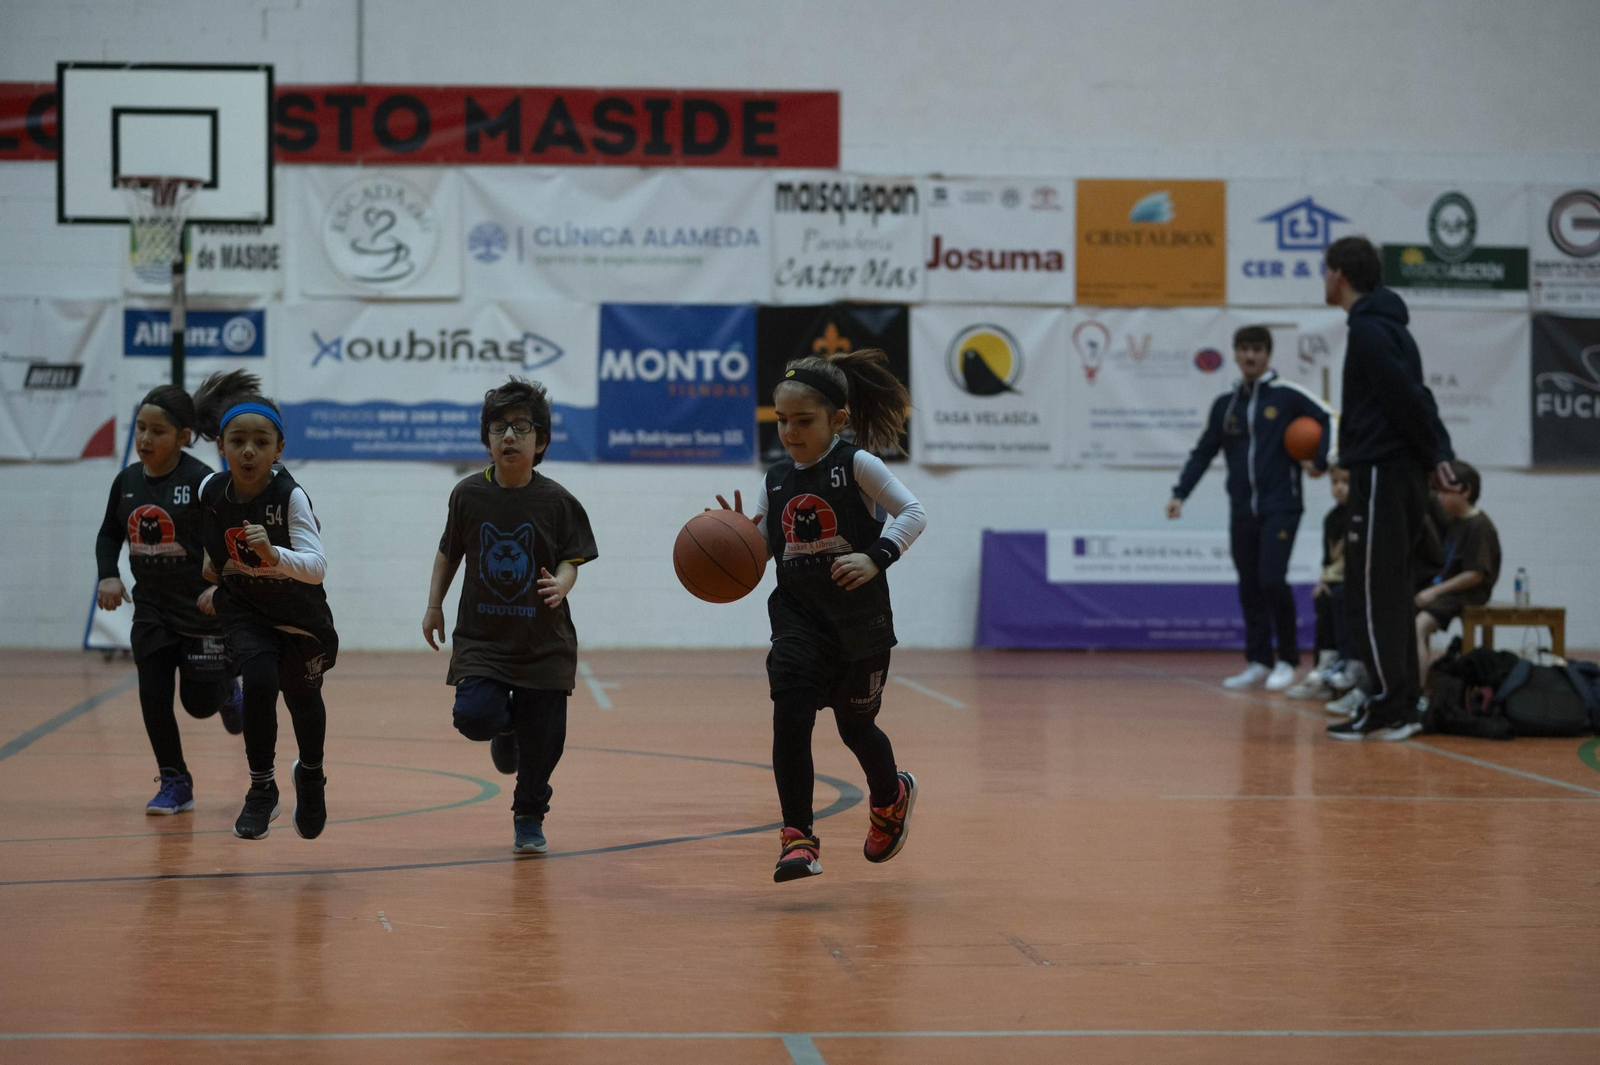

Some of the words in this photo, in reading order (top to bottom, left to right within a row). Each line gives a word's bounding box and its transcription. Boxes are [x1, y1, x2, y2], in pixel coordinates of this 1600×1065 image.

[465, 95, 779, 157] MASIDE
[641, 225, 761, 248] ALAMEDA
[197, 243, 215, 270] de
[220, 245, 279, 270] MASIDE
[925, 235, 1065, 271] Josuma
[830, 465, 848, 488] 51
[173, 485, 191, 505] 56
[265, 503, 283, 526] 54
[815, 539, 838, 550] Libros
